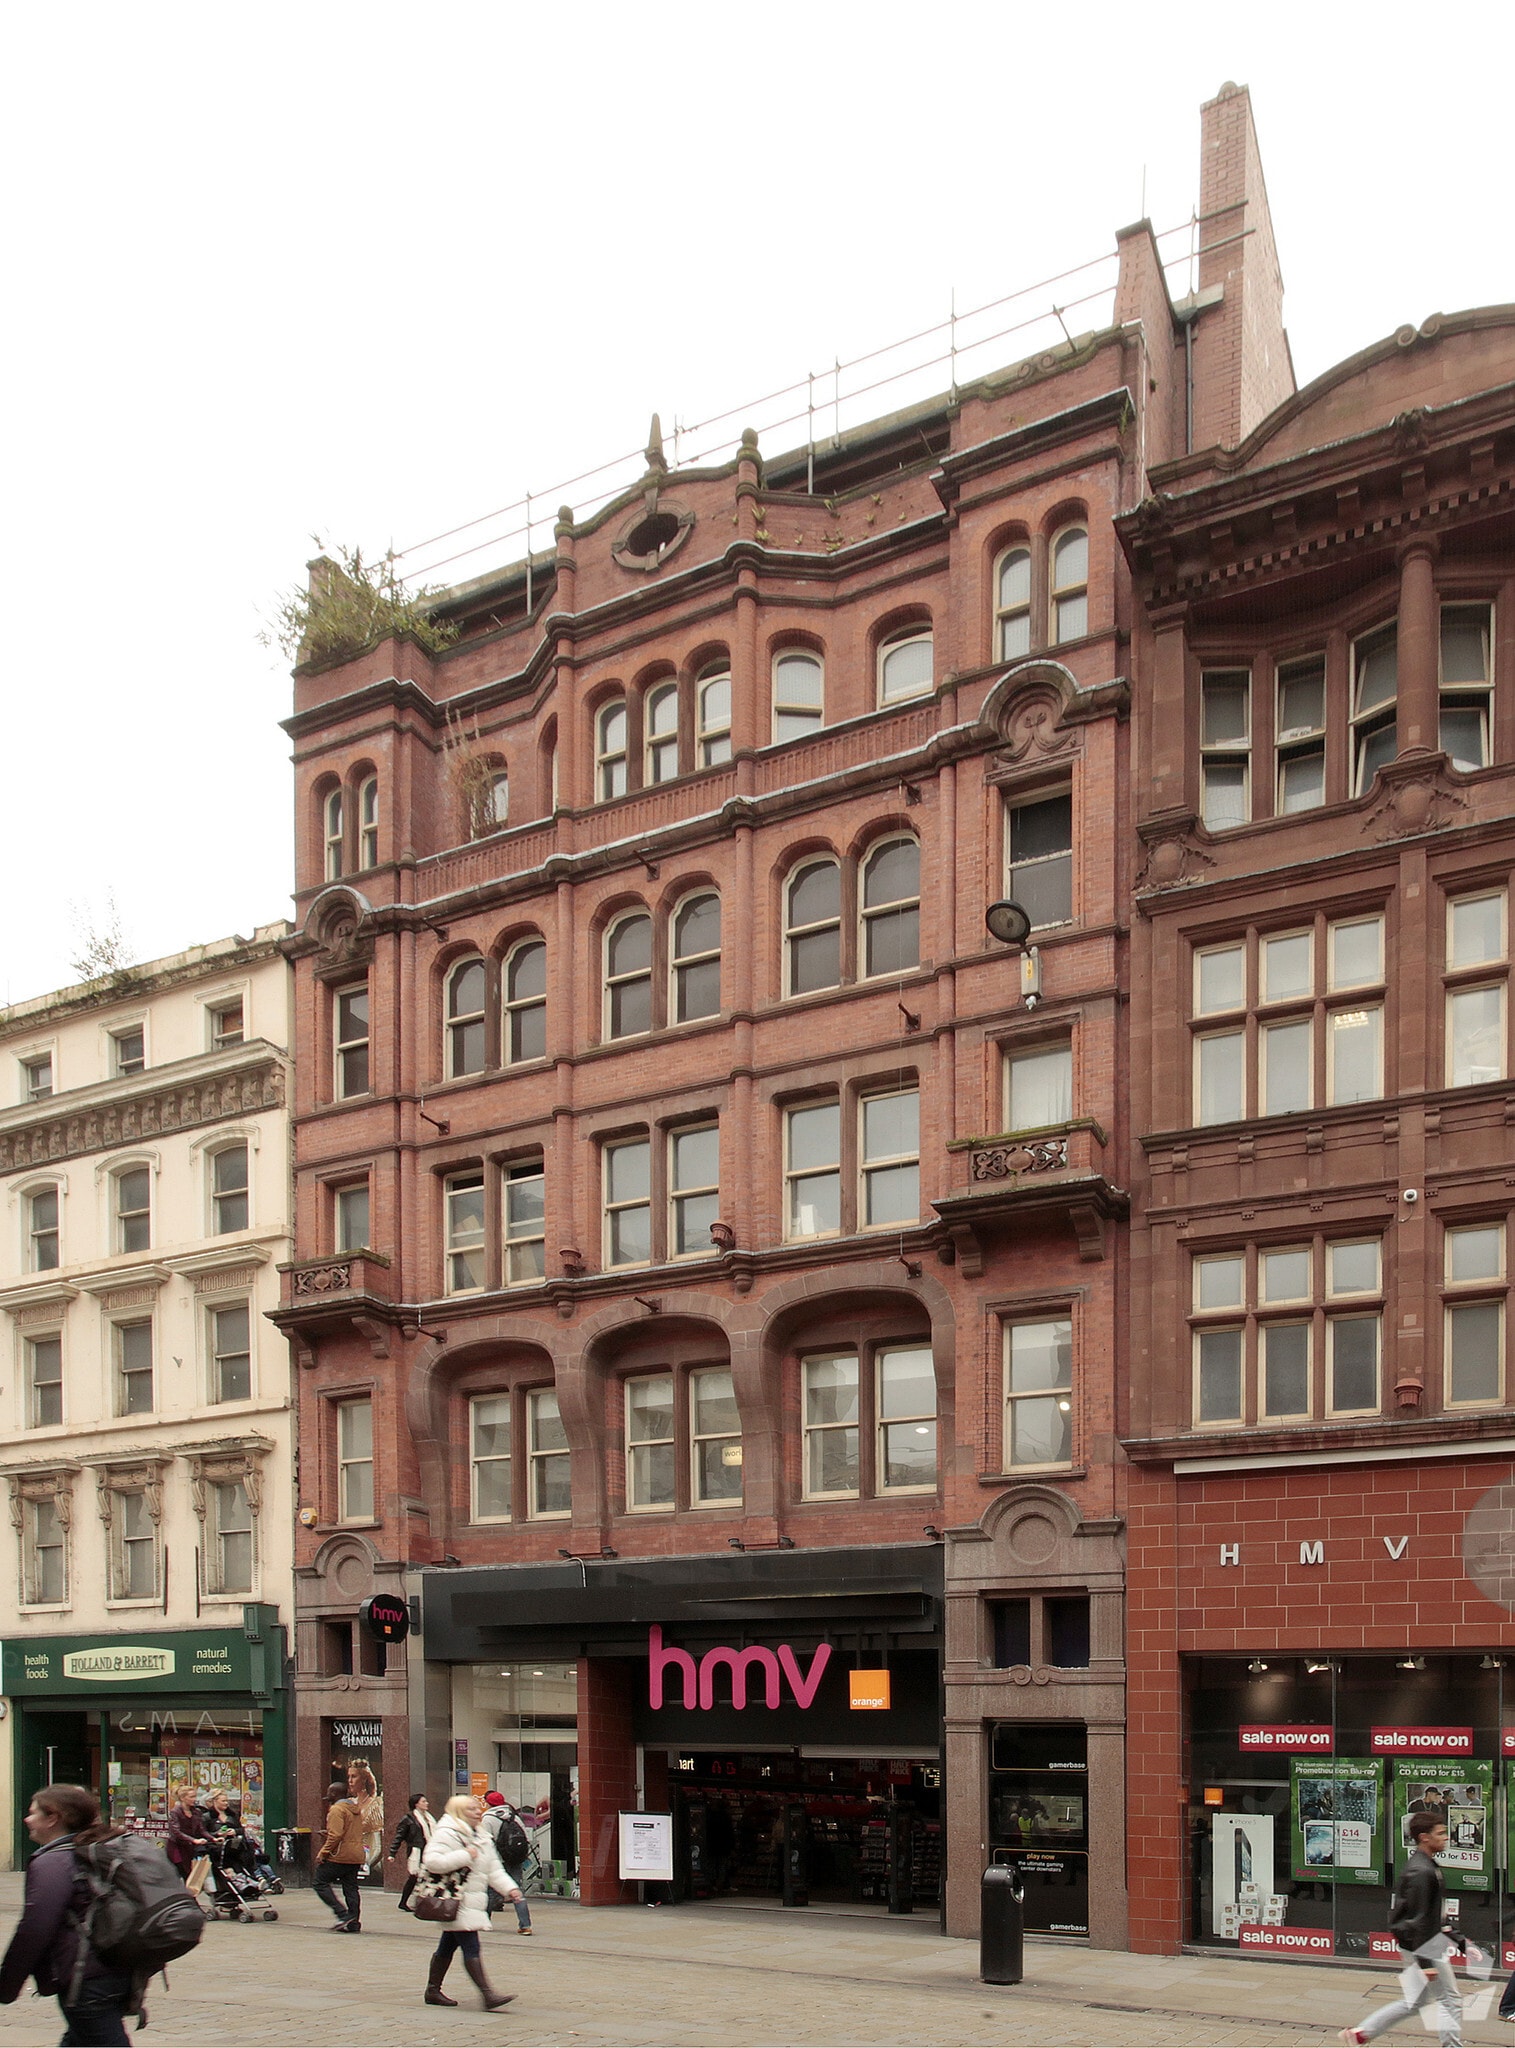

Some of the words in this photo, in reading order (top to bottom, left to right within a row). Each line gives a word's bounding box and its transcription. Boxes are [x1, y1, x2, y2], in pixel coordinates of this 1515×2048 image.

[371, 1602, 404, 1623] hmv
[196, 1647, 228, 1659] natural
[25, 1654, 49, 1666] health
[71, 1657, 112, 1673] HOLLAND
[113, 1656, 123, 1672] &
[124, 1654, 167, 1671] BARRETT
[26, 1667, 49, 1679] foods
[192, 1662, 232, 1674] remedies
[649, 1623, 833, 1711] hmv
[852, 1698, 884, 1708] orange
[1242, 1730, 1273, 1744] sale
[1275, 1733, 1308, 1744] now
[1309, 1733, 1330, 1744] on
[1374, 1732, 1407, 1746] sale
[1410, 1735, 1445, 1747] now
[1447, 1735, 1469, 1747] on
[1048, 1761, 1086, 1769] gamerbase
[1350, 1767, 1376, 1776] Blu-ray
[1399, 1768, 1411, 1776] CD
[1450, 1769, 1466, 1777] £15
[1342, 1828, 1360, 1837] £14
[1460, 1852, 1480, 1861] £15
[1050, 1923, 1087, 1932] gamerbase
[1242, 1930, 1274, 1944] sale
[1276, 1932, 1309, 1945] now
[1310, 1934, 1331, 1948] on
